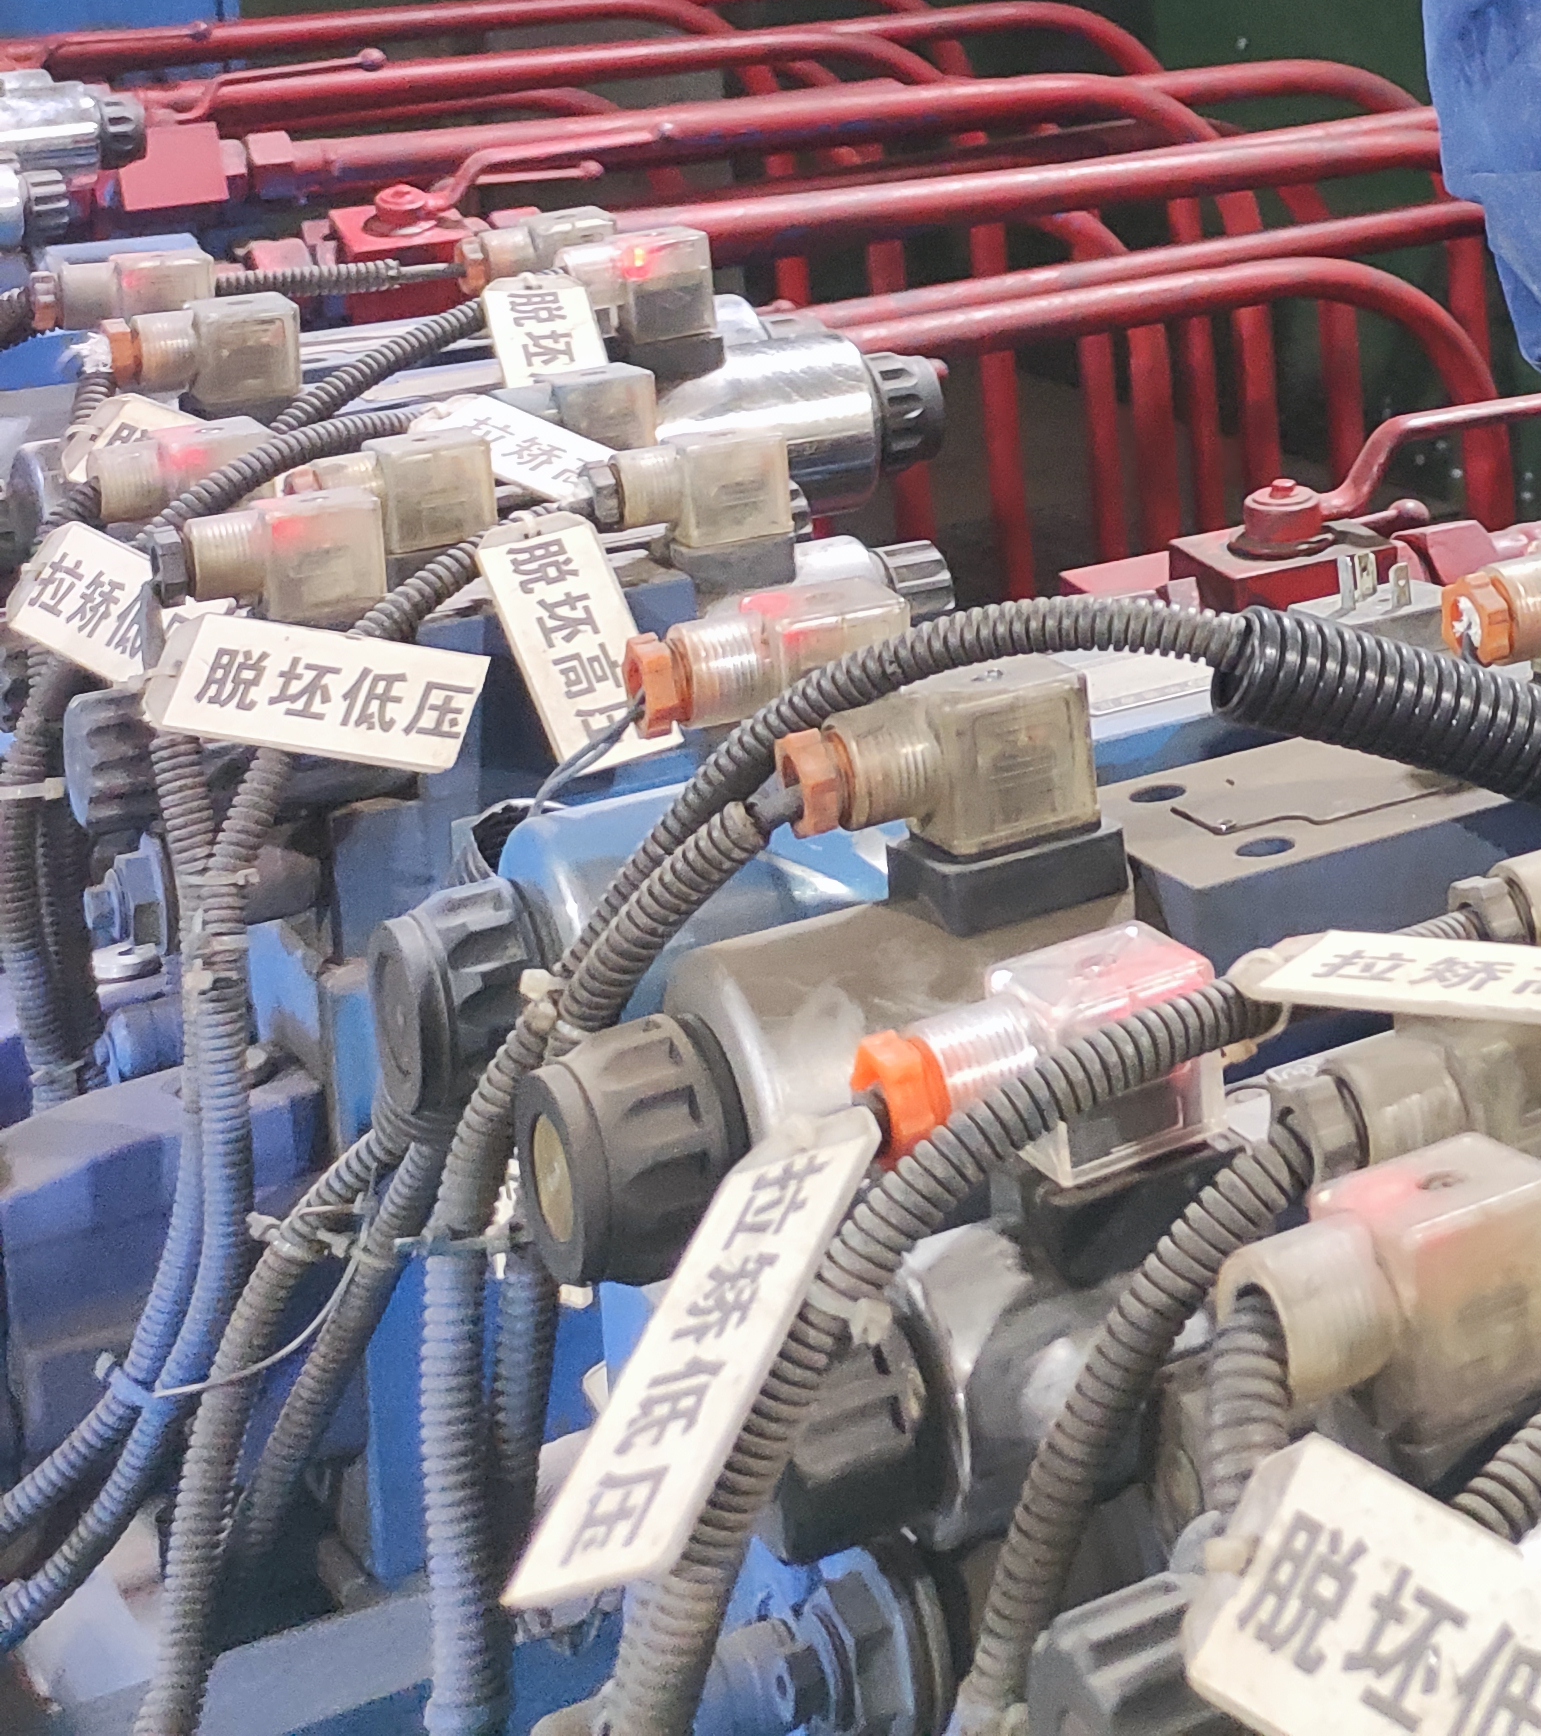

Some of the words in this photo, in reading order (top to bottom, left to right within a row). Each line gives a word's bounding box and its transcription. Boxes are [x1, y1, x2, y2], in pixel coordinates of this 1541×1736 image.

[506, 291, 576, 382] 脱坯
[194, 647, 476, 739] 脱坯低压
[560, 1147, 835, 1568] 拉矫低压
